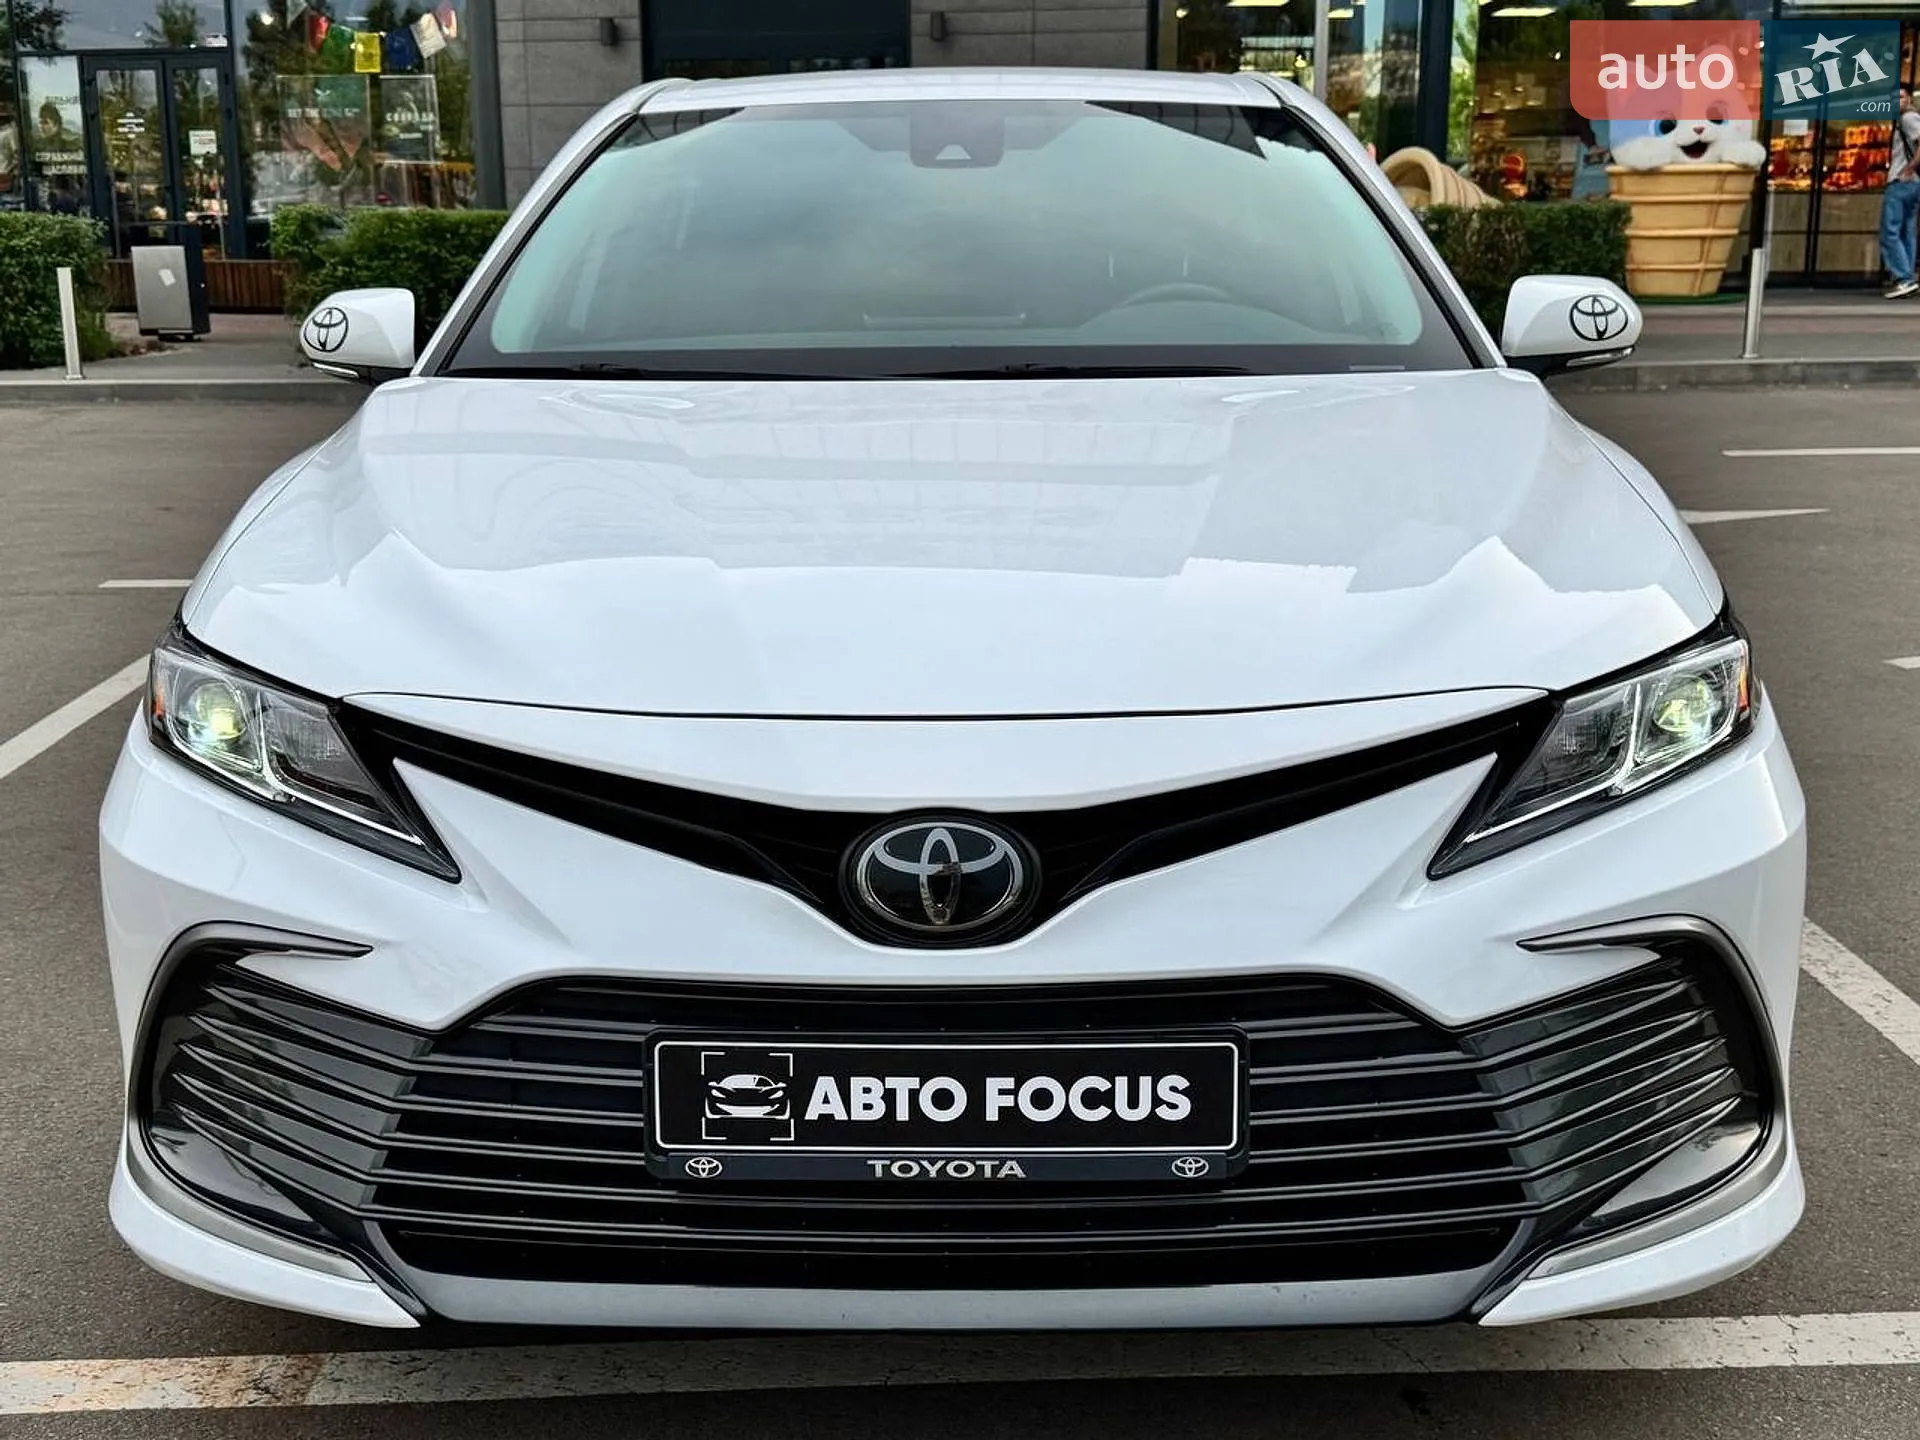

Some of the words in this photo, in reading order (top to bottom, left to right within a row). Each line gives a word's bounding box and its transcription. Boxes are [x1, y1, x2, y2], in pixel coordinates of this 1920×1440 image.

[804, 1075, 968, 1122] АВТО
[985, 1074, 1192, 1122] FOCUS
[866, 1159, 1026, 1178] TOYOTA
